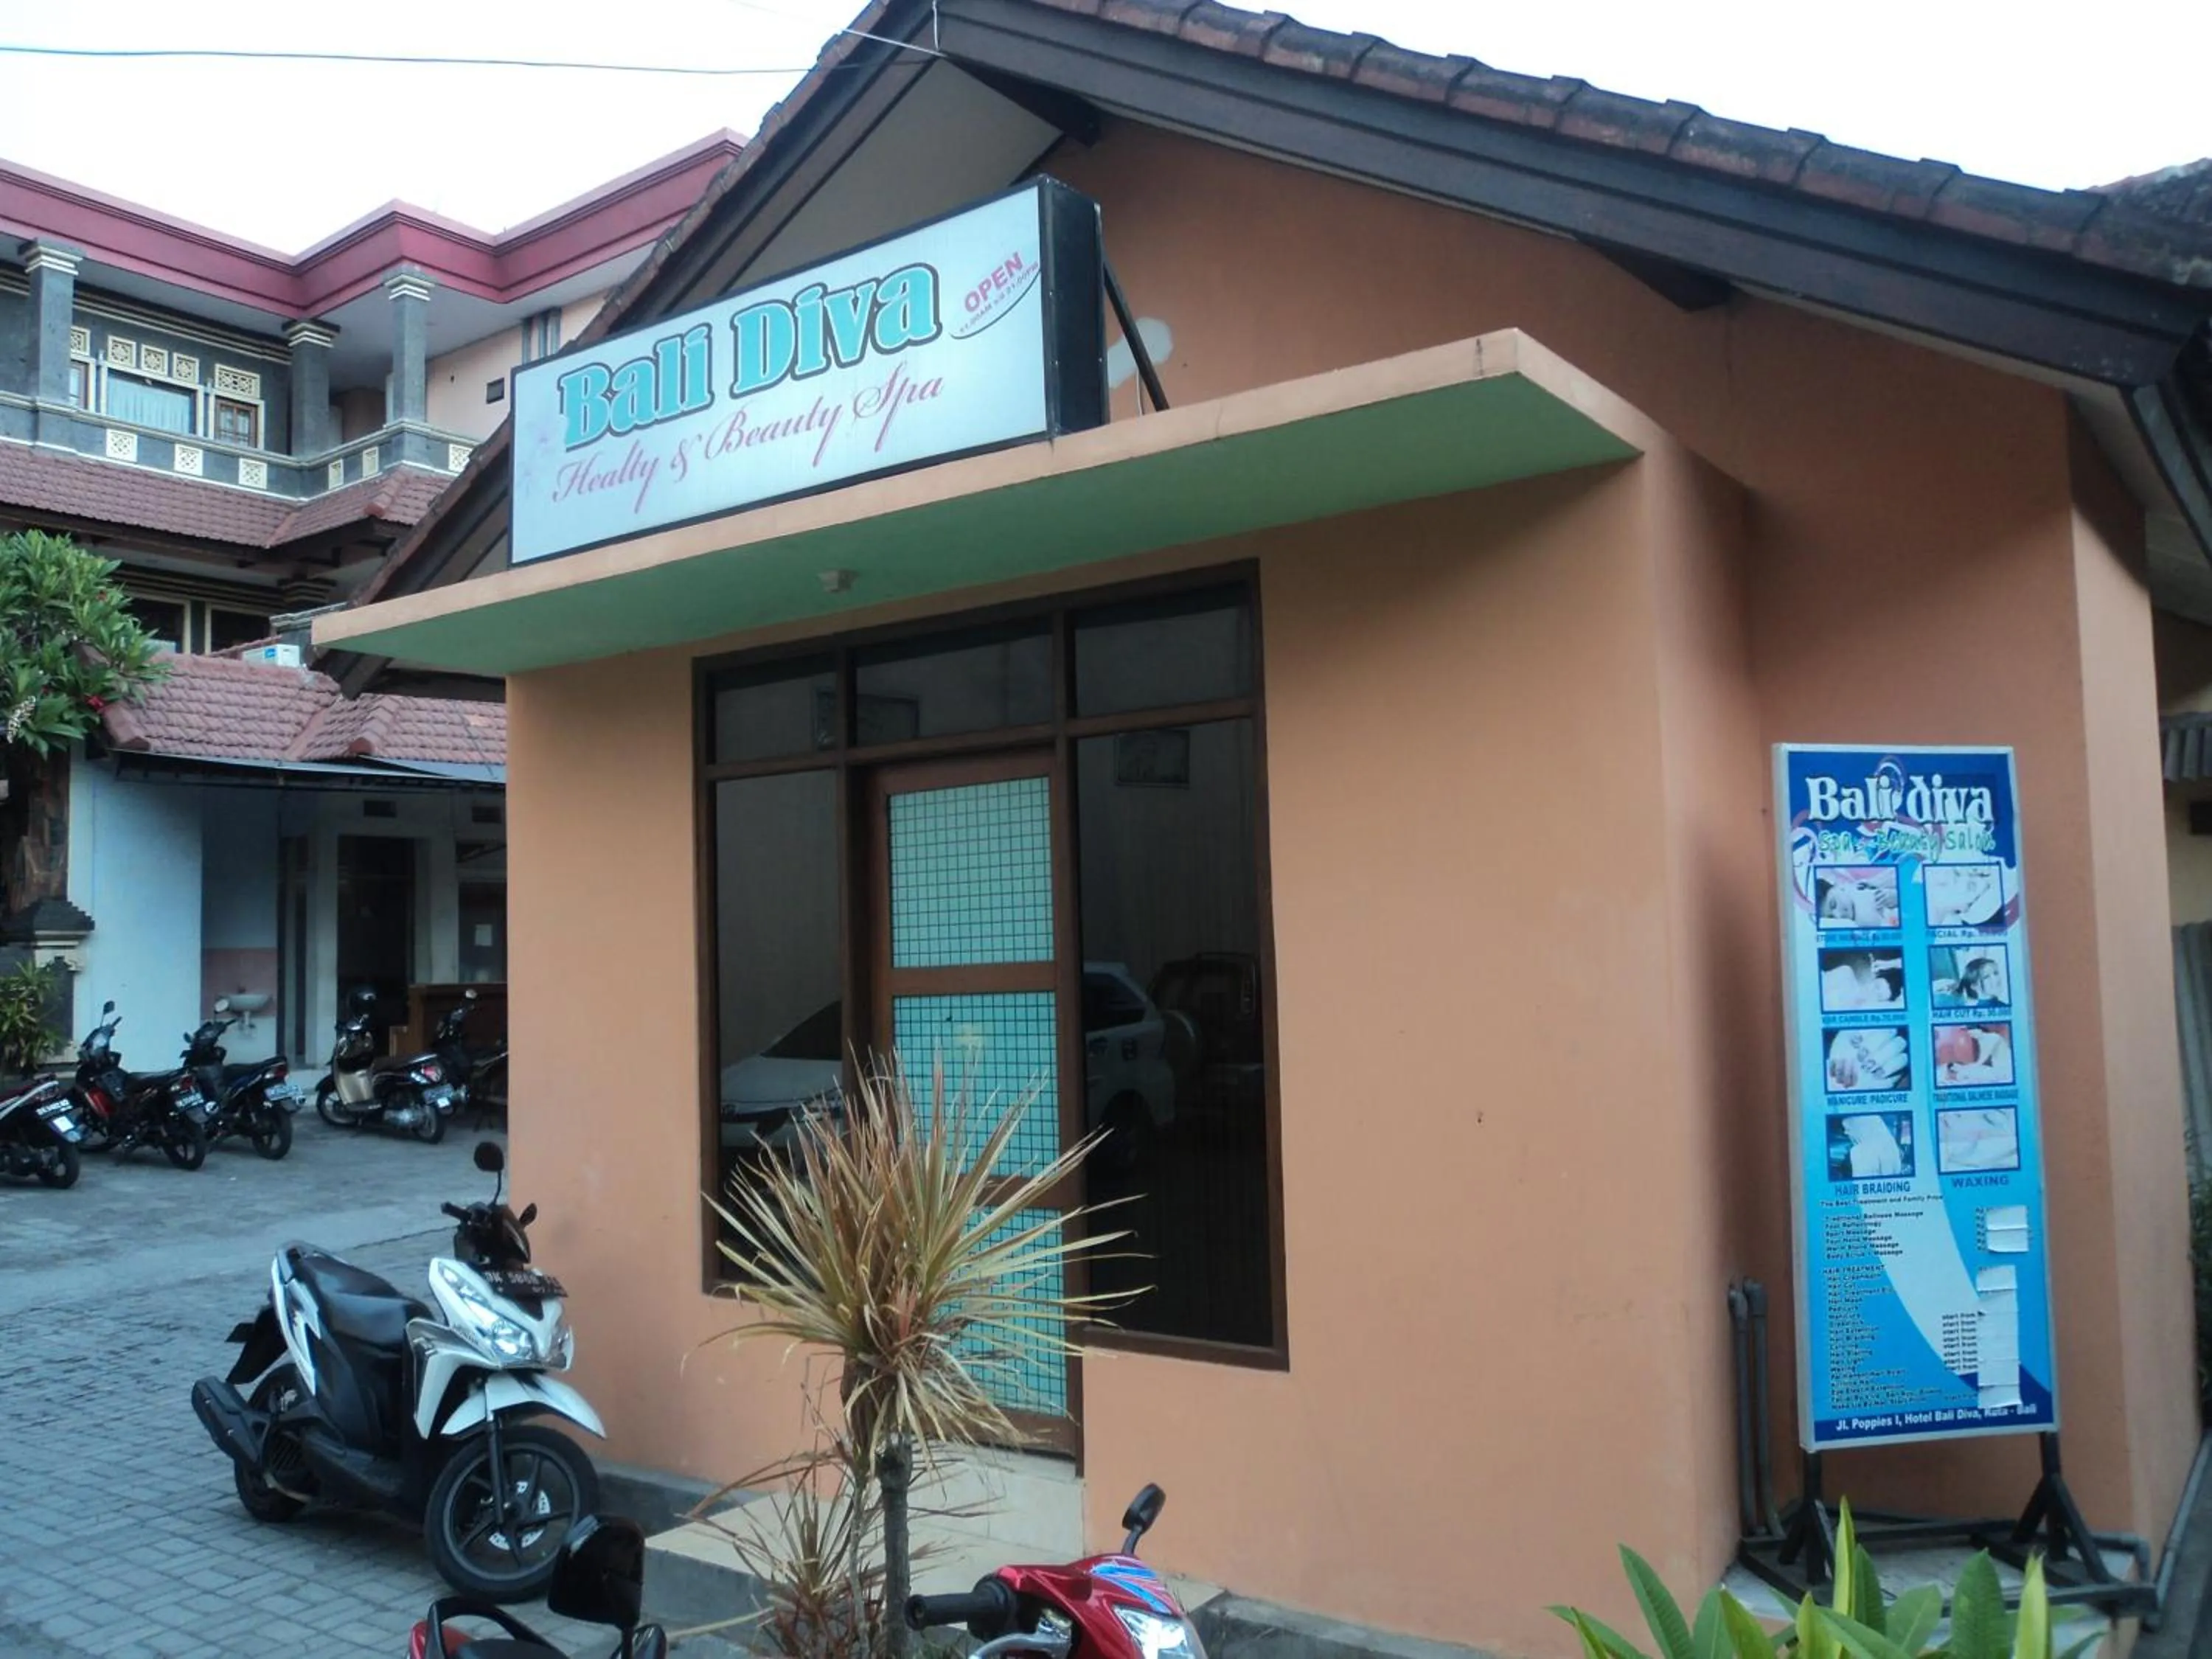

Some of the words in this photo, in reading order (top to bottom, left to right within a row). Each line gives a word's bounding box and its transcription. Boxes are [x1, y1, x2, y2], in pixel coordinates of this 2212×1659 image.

[964, 250, 1023, 313] OPEN
[557, 322, 714, 451] Bali
[729, 262, 943, 398] Diva
[553, 442, 658, 514] Healty
[671, 436, 702, 481] &
[704, 398, 844, 467] Beauty
[852, 361, 945, 452] Spa
[1806, 774, 1898, 822] Bali
[1906, 773, 1995, 824] diva
[1835, 1184, 1859, 1195] HAIR
[1862, 1181, 1910, 1194] BRAIDING
[1952, 1175, 2009, 1189] WAXING
[1852, 1416, 1892, 1430] Poppies
[1905, 1411, 1933, 1425] Hotel
[1935, 1410, 1955, 1422] Bali
[1957, 1408, 1982, 1420] Diva,
[2017, 1403, 2037, 1416] Bali
